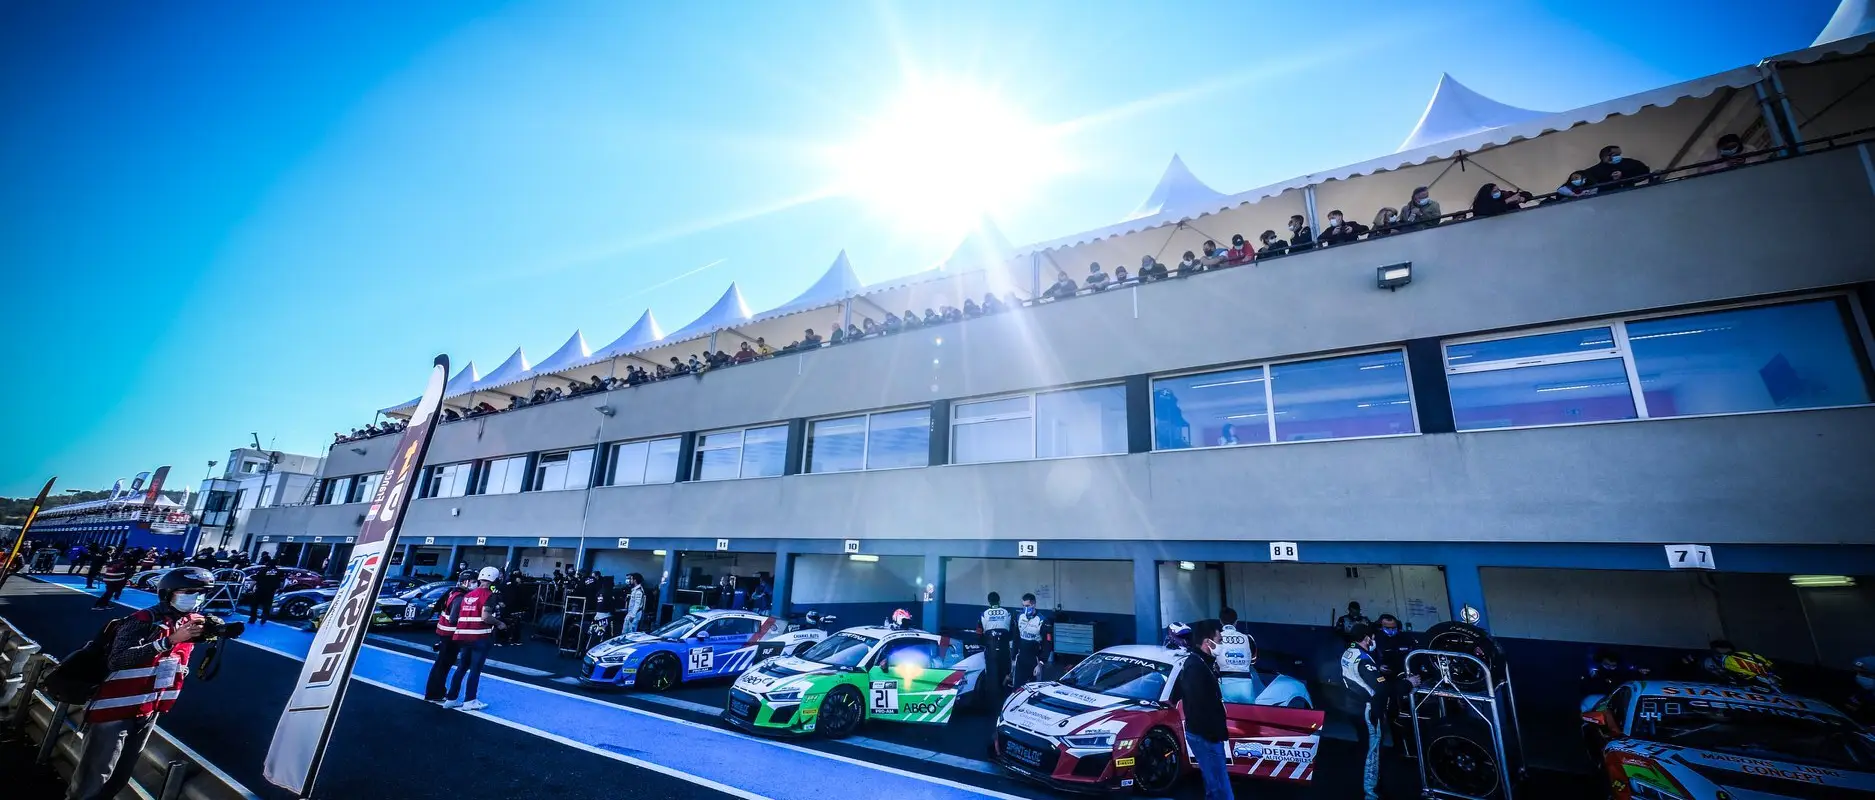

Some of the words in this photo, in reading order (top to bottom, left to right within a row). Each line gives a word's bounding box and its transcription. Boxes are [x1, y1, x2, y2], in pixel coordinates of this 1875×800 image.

[1027, 544, 1034, 553] 9
[692, 653, 709, 669] 42
[1104, 655, 1156, 670] CERTINA
[875, 690, 888, 708] 21
[1025, 709, 1052, 721] Santander
[1263, 747, 1312, 760] DEBARD
[1265, 755, 1313, 764] AUTOMOBILES
[1701, 753, 1774, 767] MAISONS
[1742, 765, 1825, 783] CONCEPT
